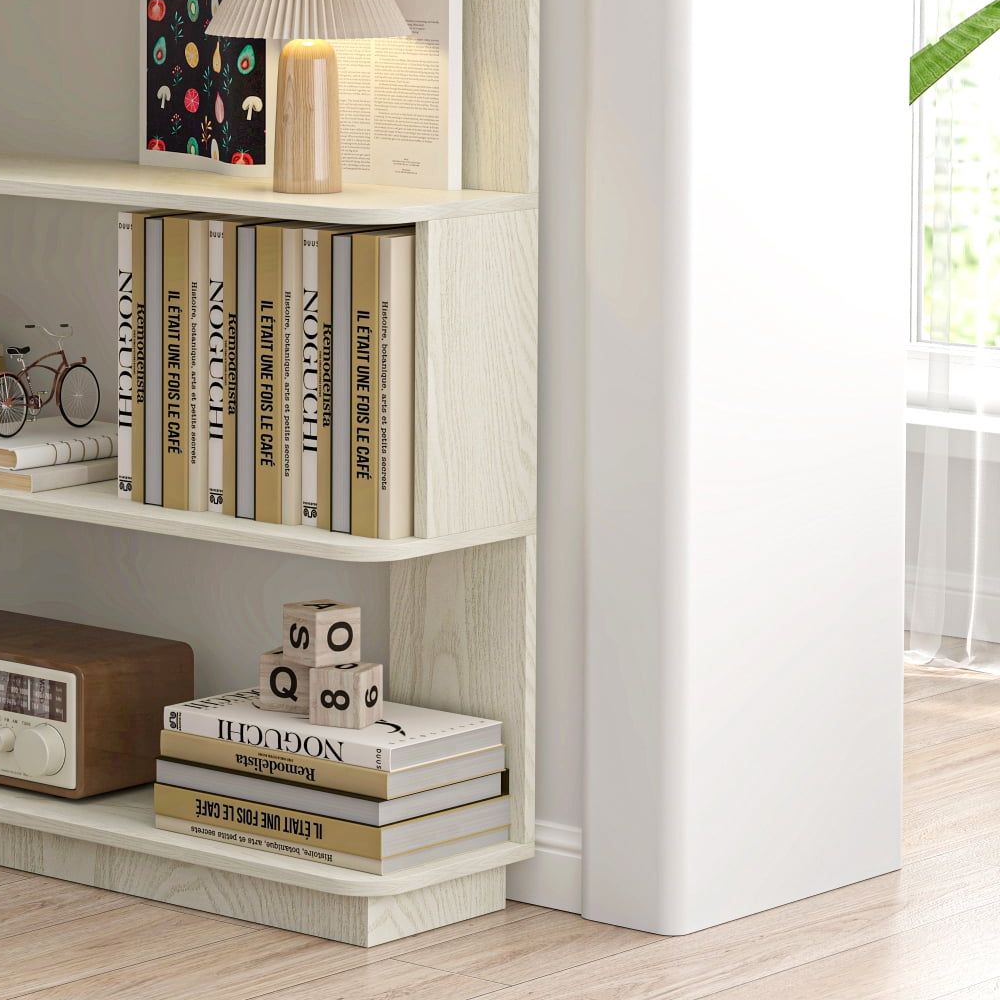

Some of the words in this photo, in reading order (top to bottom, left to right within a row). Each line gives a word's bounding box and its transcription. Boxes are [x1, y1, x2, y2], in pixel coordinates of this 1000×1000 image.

[356, 310, 370, 323] IL
[118, 269, 132, 428] NOGUCHI
[209, 277, 224, 440] NOGUCHI
[356, 325, 373, 362] ÉTAIT
[303, 288, 318, 453] NOGUCHI
[356, 364, 370, 392] UNE
[356, 395, 370, 425] FOIS
[356, 427, 370, 444] LE
[356, 448, 372, 481] CAFÉ
[289, 622, 310, 650] S
[269, 666, 298, 702] Q
[320, 689, 350, 711] 8
[217, 718, 344, 762] NOGUCHI
[235, 753, 316, 782] Remodelista
